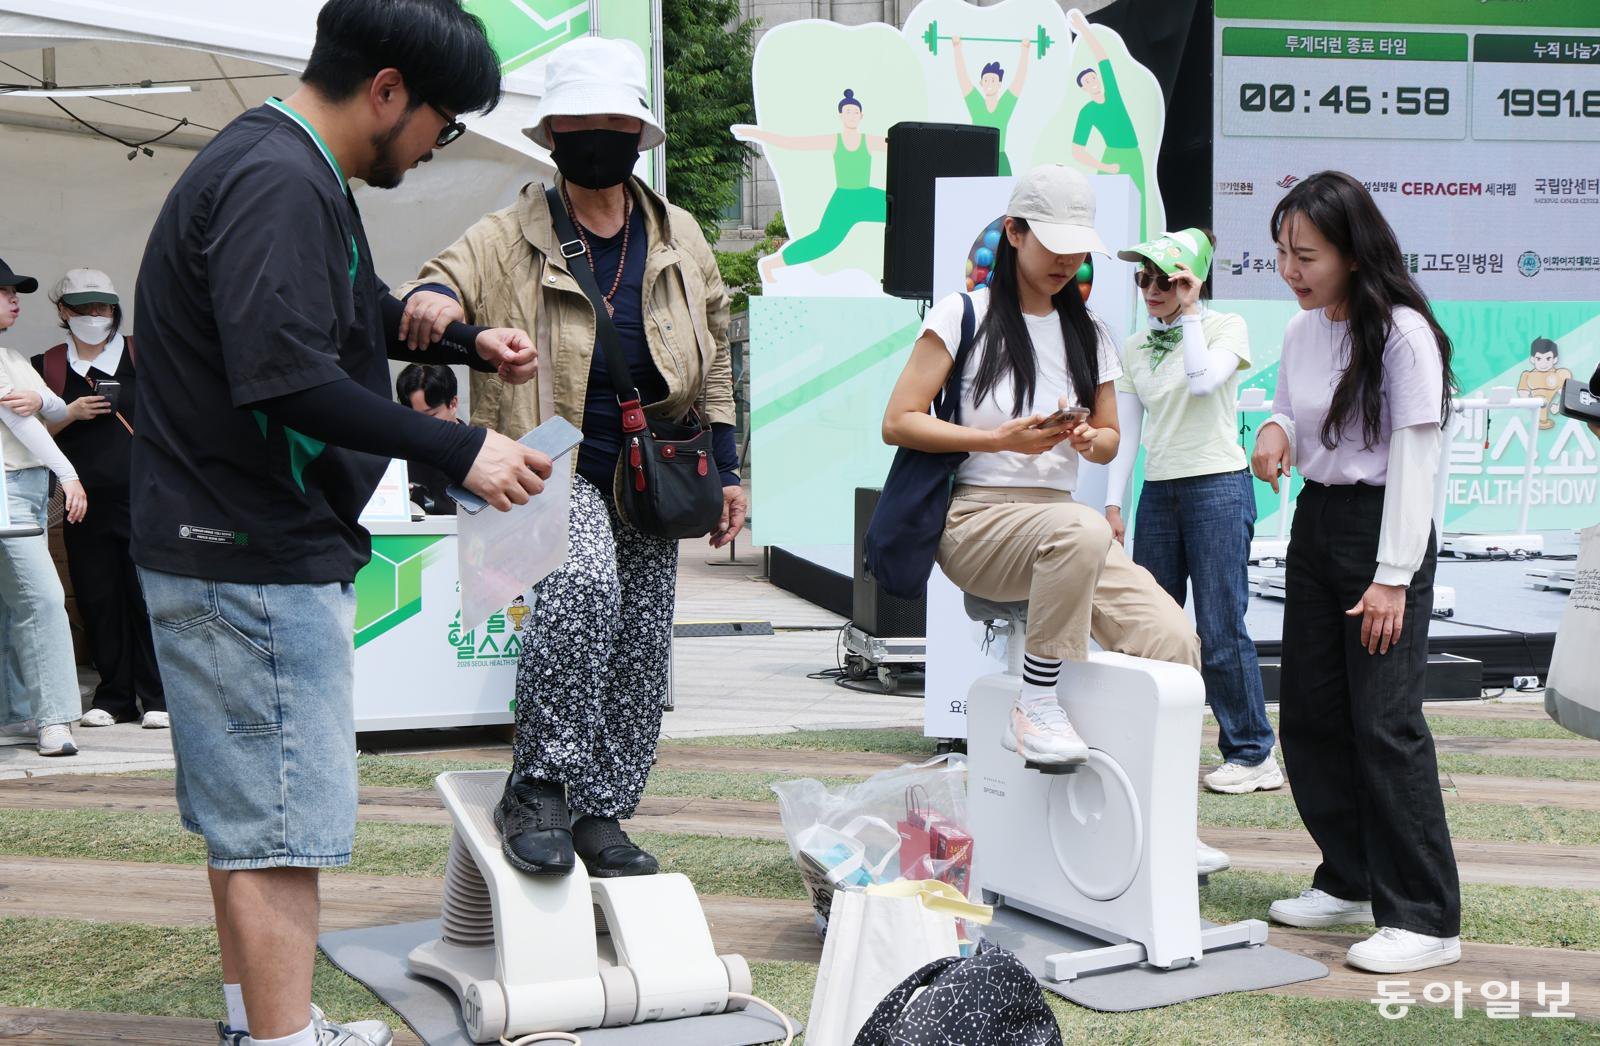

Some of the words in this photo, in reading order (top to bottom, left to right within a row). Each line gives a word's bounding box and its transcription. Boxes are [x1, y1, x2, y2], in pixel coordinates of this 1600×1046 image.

[1285, 36, 1342, 54] 투게더런
[1346, 38, 1375, 54] 종료
[1379, 38, 1407, 55] 타임
[1533, 41, 1560, 59] 누적
[1402, 182, 1482, 196] CERAGEM
[1485, 183, 1517, 196] 세라젬
[1534, 178, 1600, 196] 국립암센터
[1421, 253, 1503, 275] 고도일병원
[1528, 479, 1596, 505] SHOW
